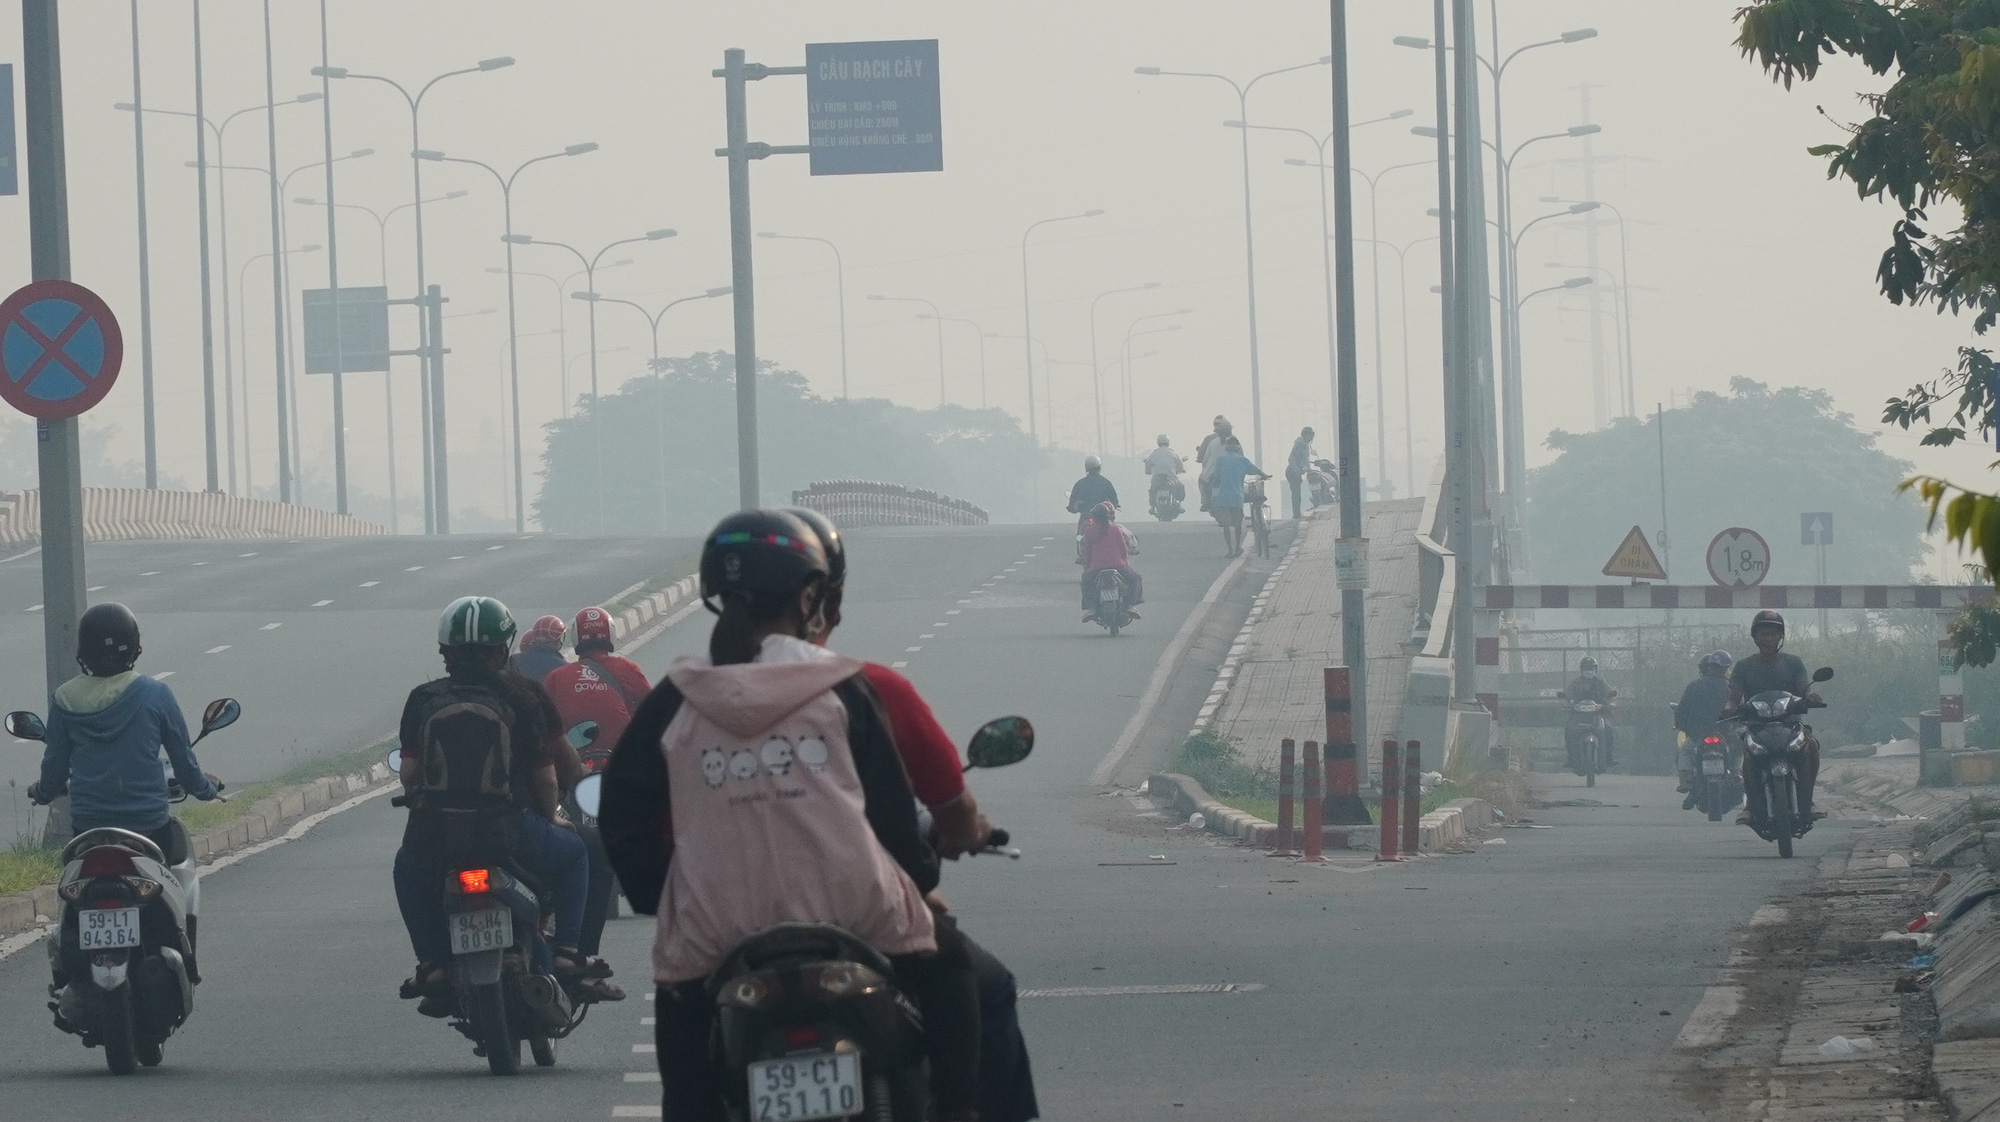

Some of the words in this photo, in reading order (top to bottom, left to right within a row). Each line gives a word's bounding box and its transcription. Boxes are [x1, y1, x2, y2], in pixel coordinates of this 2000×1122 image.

[819, 56, 848, 80] CẦU
[853, 60, 890, 82] RẠCH
[894, 56, 923, 78] CÂY
[575, 682, 608, 693] goviet
[88, 911, 129, 929] 59-L1
[83, 930, 136, 947] 943.64
[460, 929, 504, 950] 8096
[765, 1058, 839, 1092] 59-C1
[758, 1084, 855, 1122] 251.10
